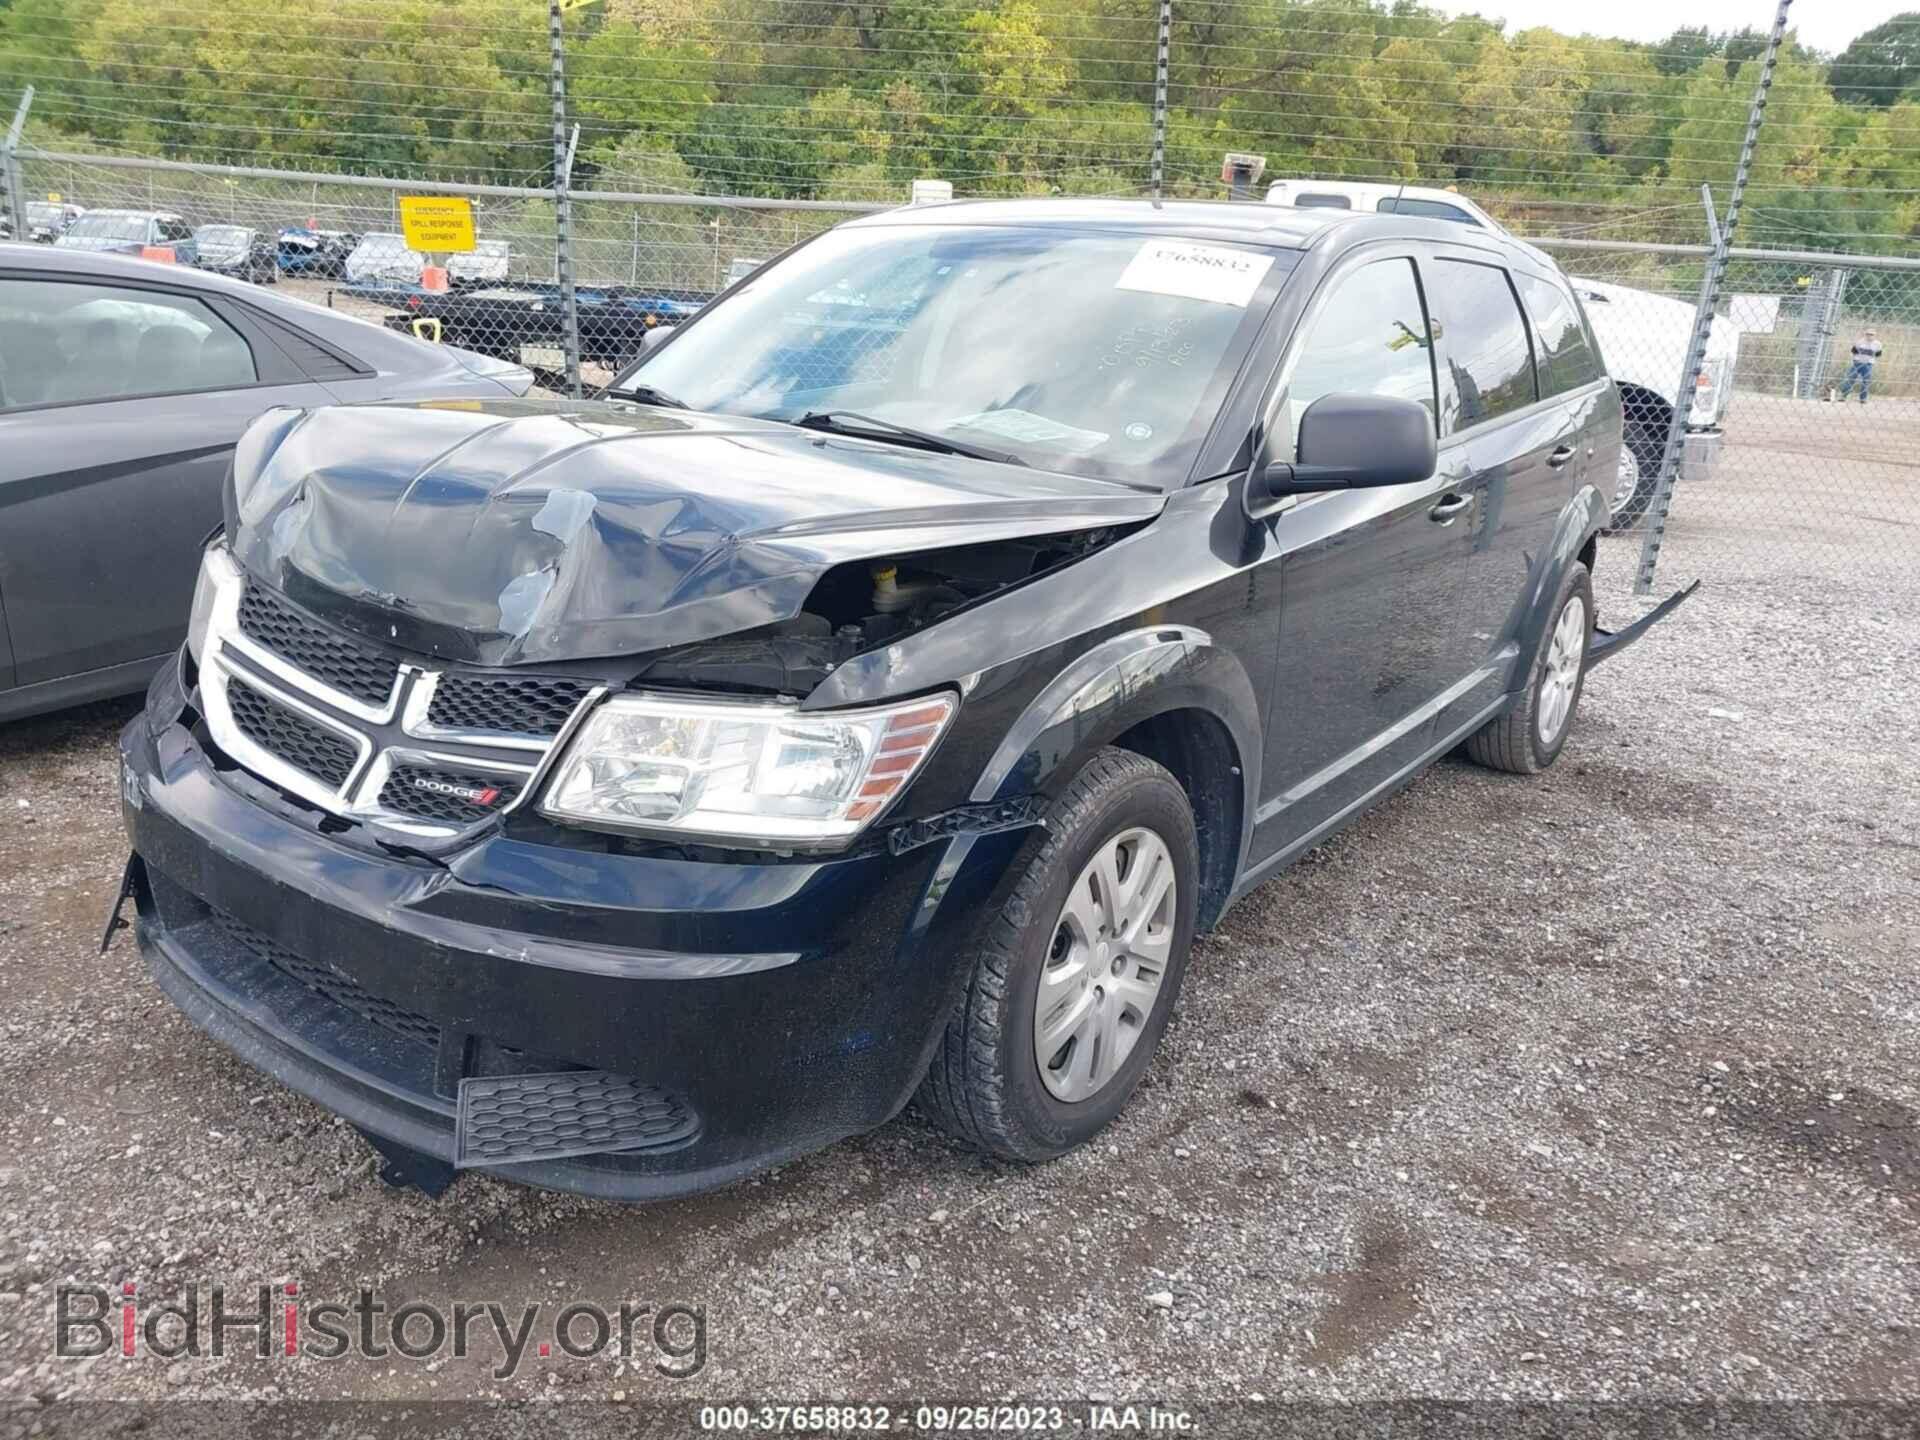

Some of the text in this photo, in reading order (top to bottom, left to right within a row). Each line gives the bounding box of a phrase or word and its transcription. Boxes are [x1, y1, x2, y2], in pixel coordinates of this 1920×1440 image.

[411, 219, 464, 228] SPILL RESPONSE
[420, 232, 457, 241] EQUIPMENT
[414, 778, 483, 800] DODGE
